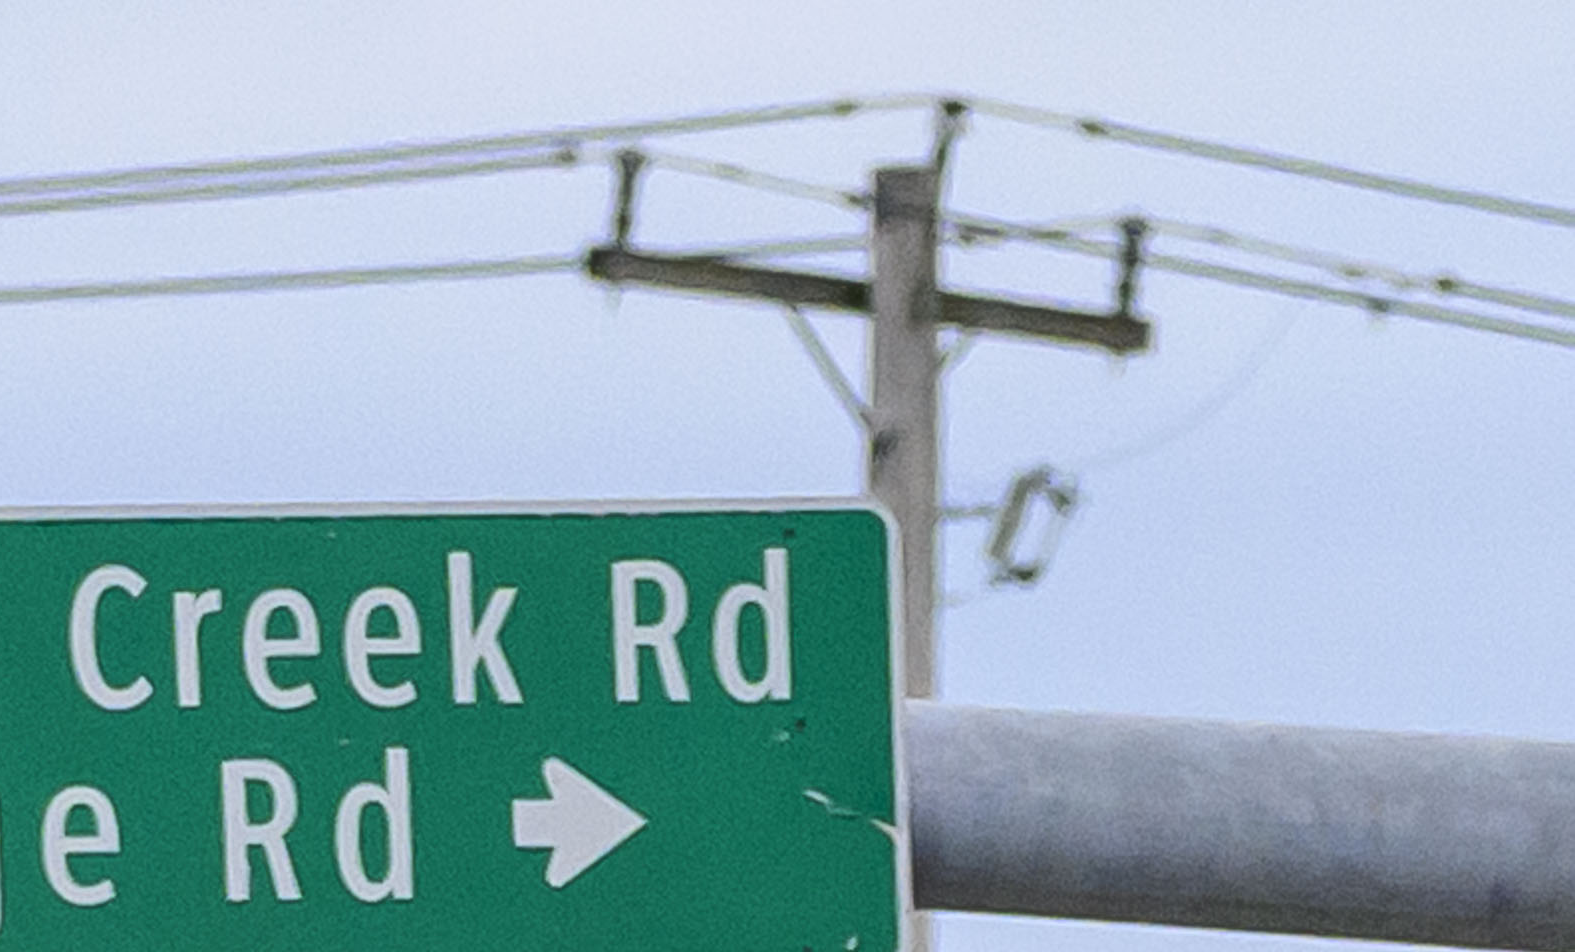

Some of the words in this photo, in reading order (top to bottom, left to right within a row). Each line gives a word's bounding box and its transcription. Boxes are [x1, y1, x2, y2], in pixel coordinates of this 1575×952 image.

[69, 550, 523, 711] Creek
[610, 547, 792, 704] Rd
[220, 746, 414, 903] Rd
